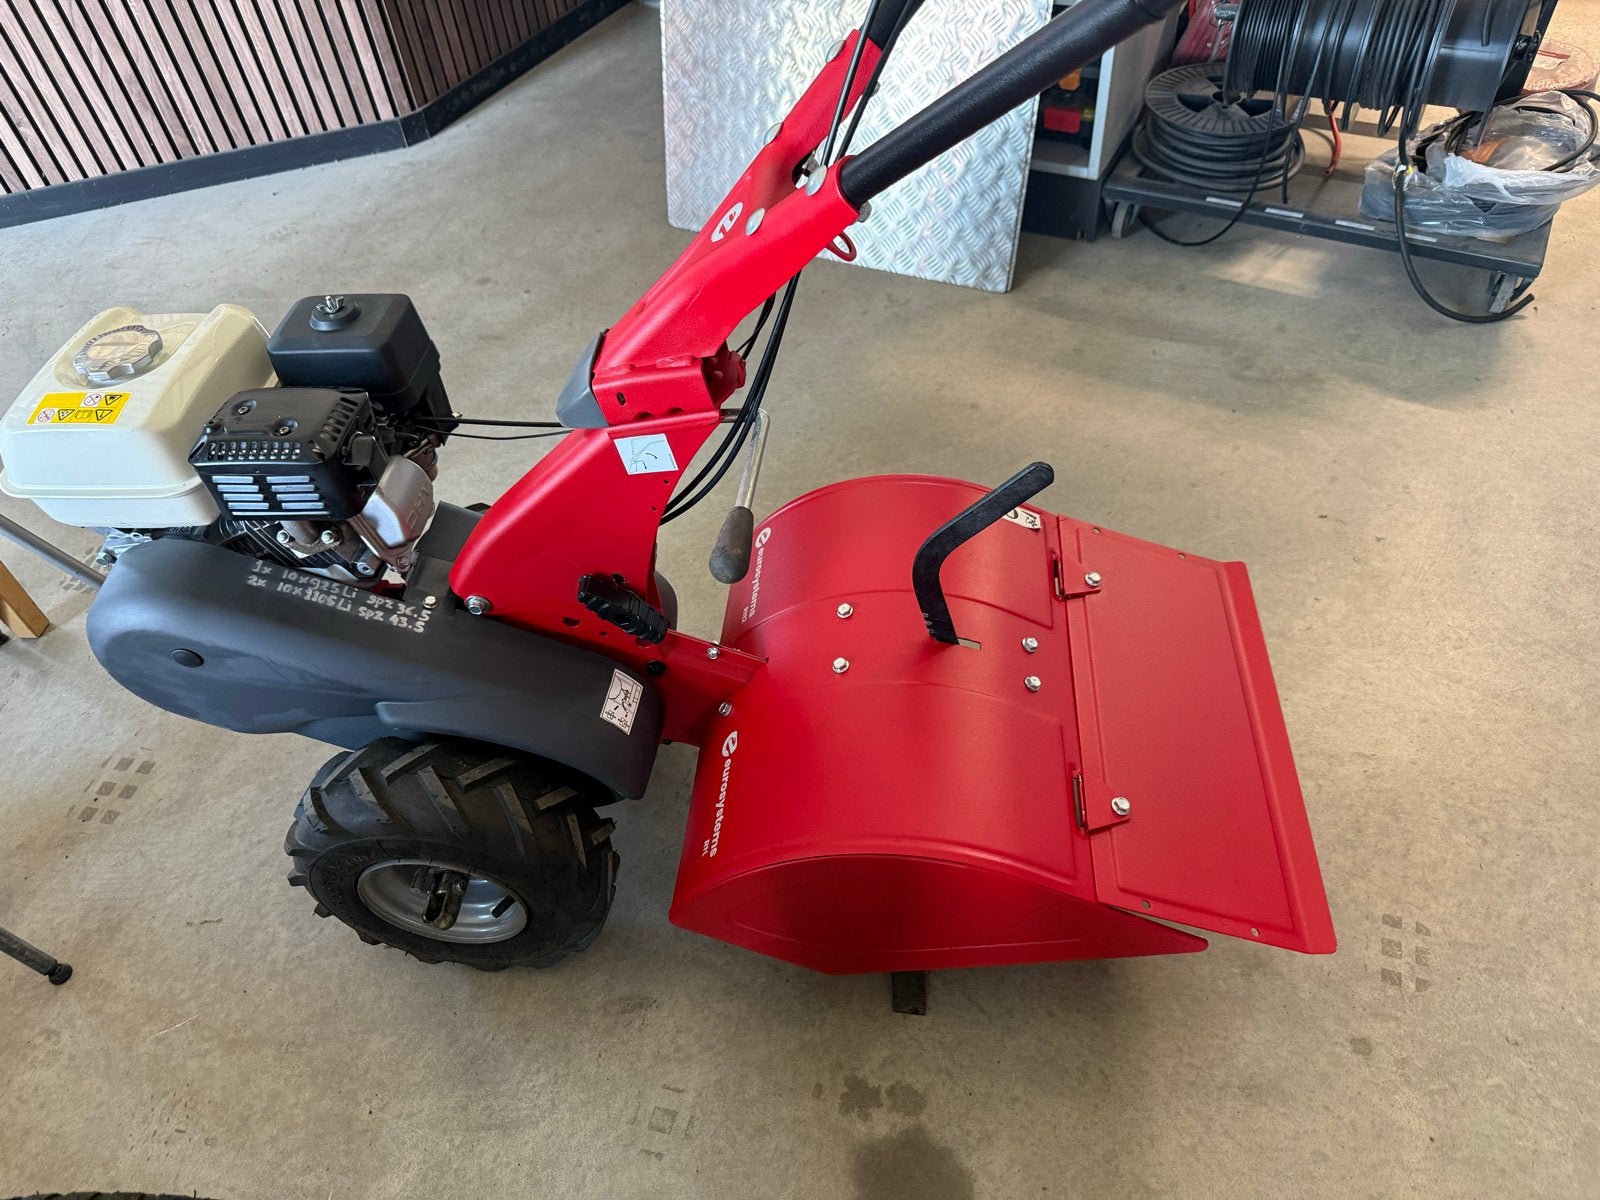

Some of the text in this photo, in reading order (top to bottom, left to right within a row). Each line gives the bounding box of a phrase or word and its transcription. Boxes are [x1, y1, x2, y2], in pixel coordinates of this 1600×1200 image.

[251, 560, 272, 575] 1x
[749, 547, 764, 618] eurosystems
[247, 574, 267, 588] 2x
[389, 613, 426, 634] 43.5
[709, 758, 732, 857] eurosystems
